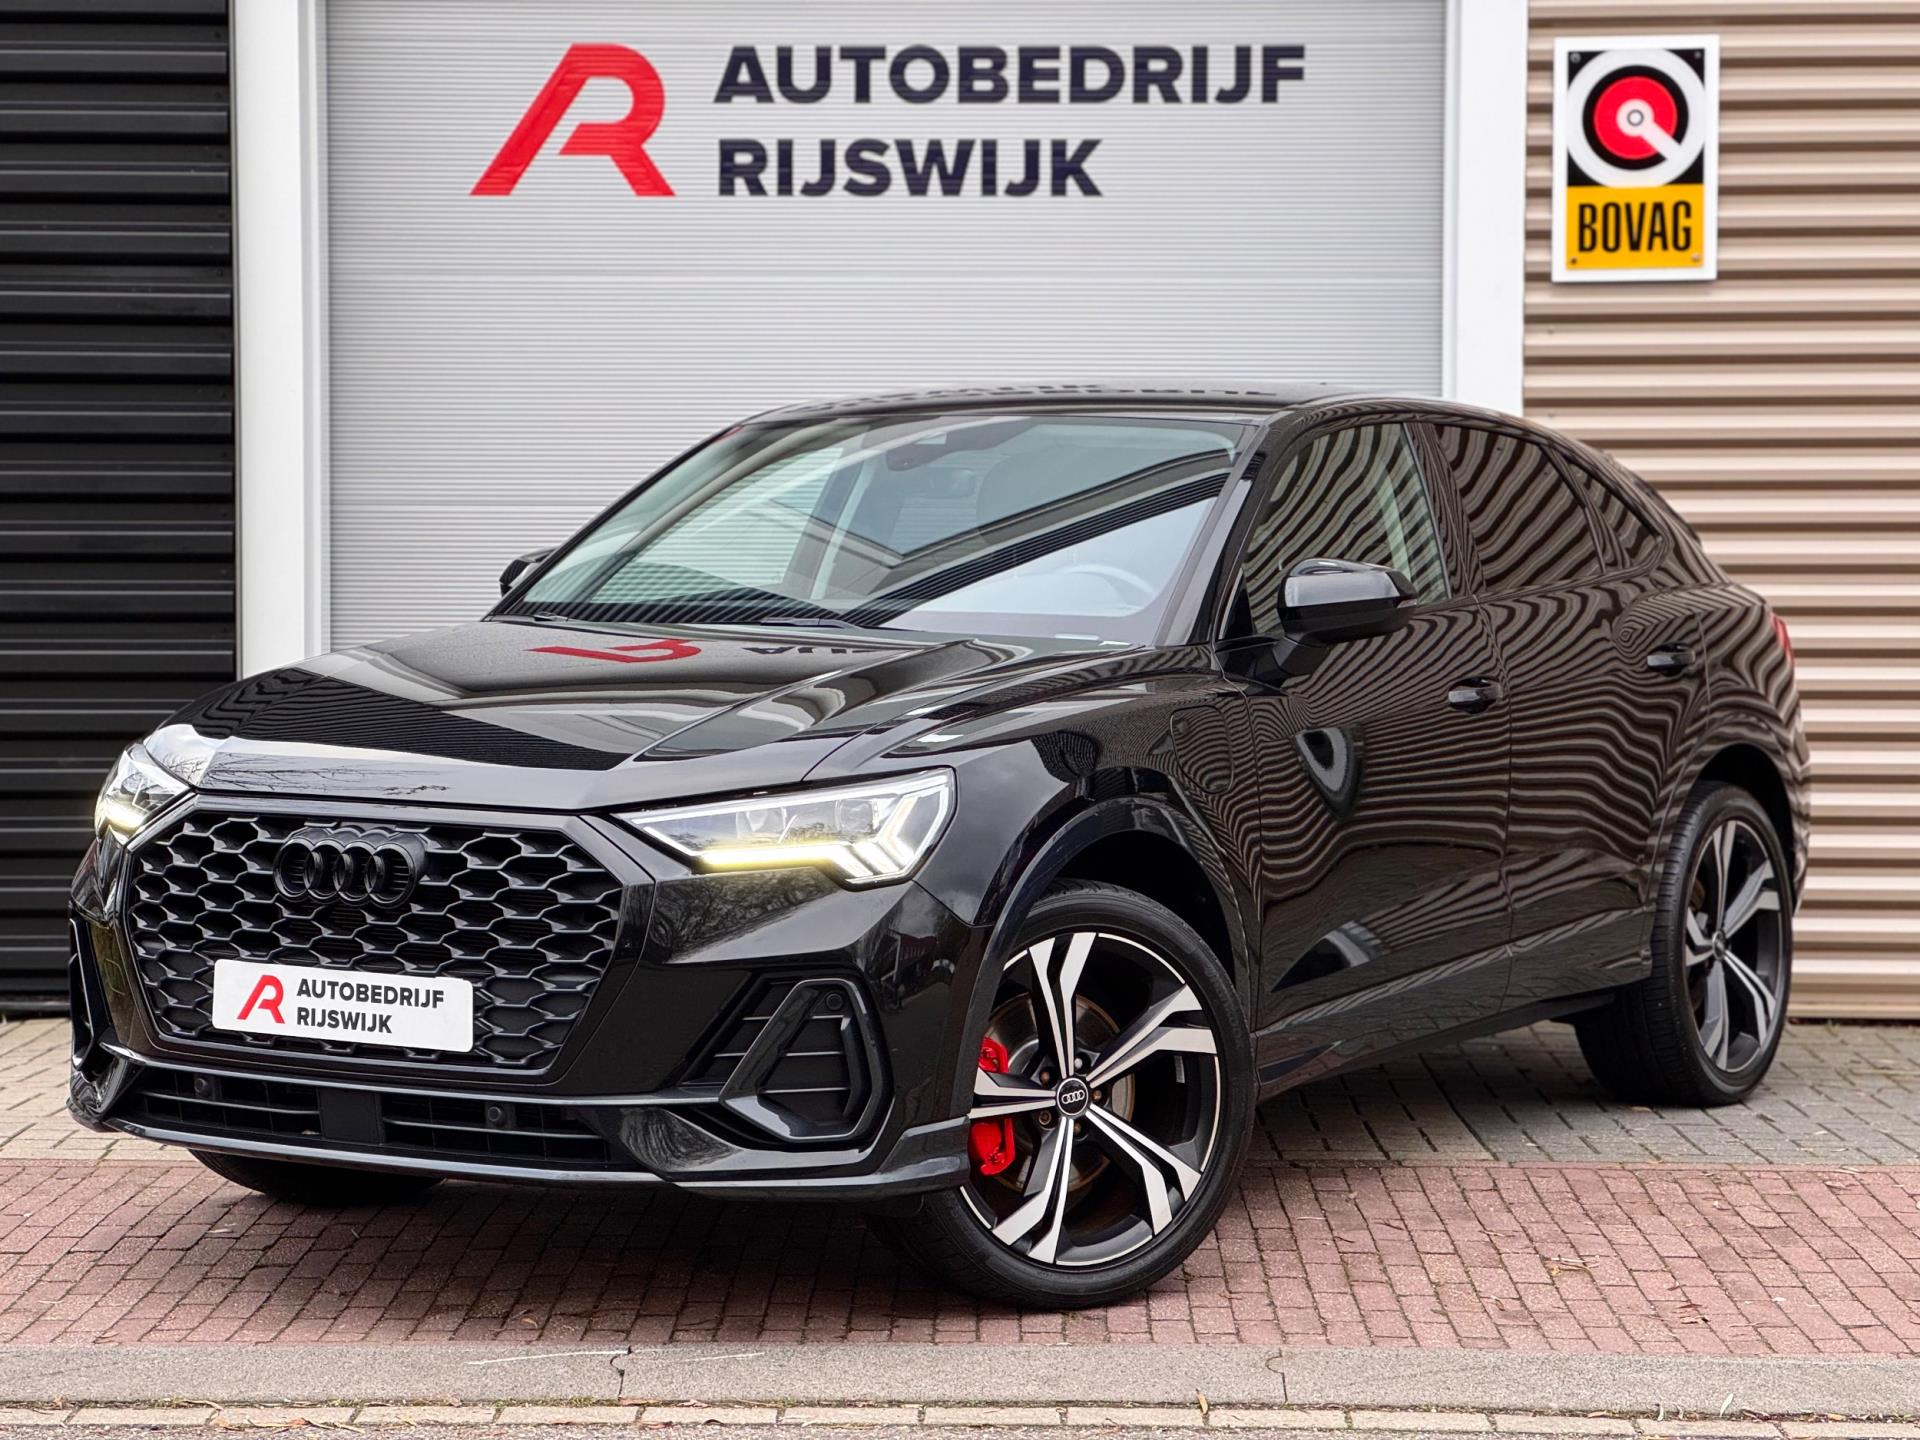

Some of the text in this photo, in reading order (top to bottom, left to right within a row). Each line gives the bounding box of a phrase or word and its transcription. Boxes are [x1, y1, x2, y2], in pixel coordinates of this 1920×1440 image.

[714, 45, 1305, 104] AUTOBEDRIJF
[718, 138, 1102, 197] RIJSWIJK
[1578, 201, 1692, 252] BOVAG
[296, 978, 444, 1008] AUTOBEDRIJF
[296, 1007, 392, 1034] RIJSWIJK
